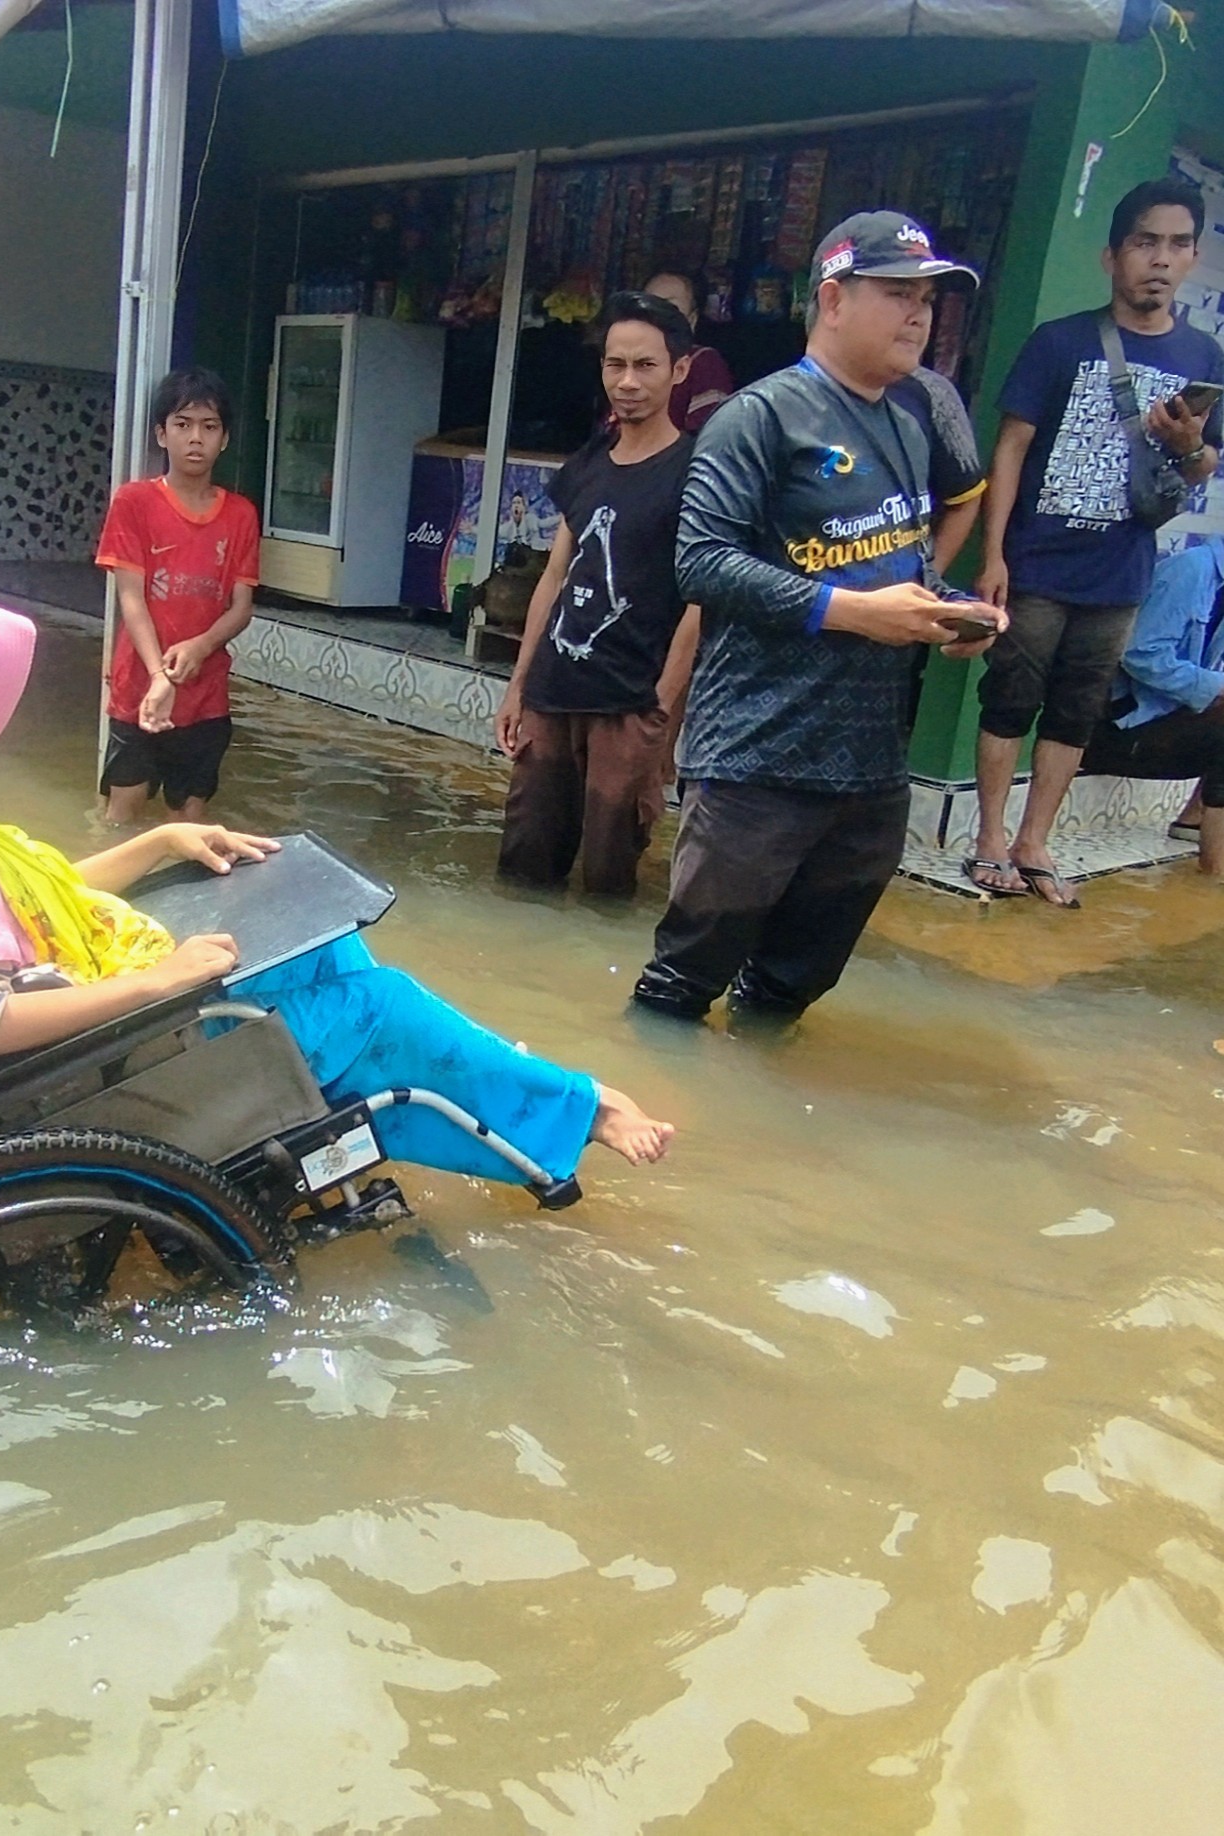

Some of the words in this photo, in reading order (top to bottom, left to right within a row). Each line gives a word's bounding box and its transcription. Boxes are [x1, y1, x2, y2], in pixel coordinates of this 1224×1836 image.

[407, 521, 444, 545] Aice
[822, 507, 886, 540] Bagawi
[1066, 518, 1111, 532] EGYPT
[787, 531, 894, 573] Banua
